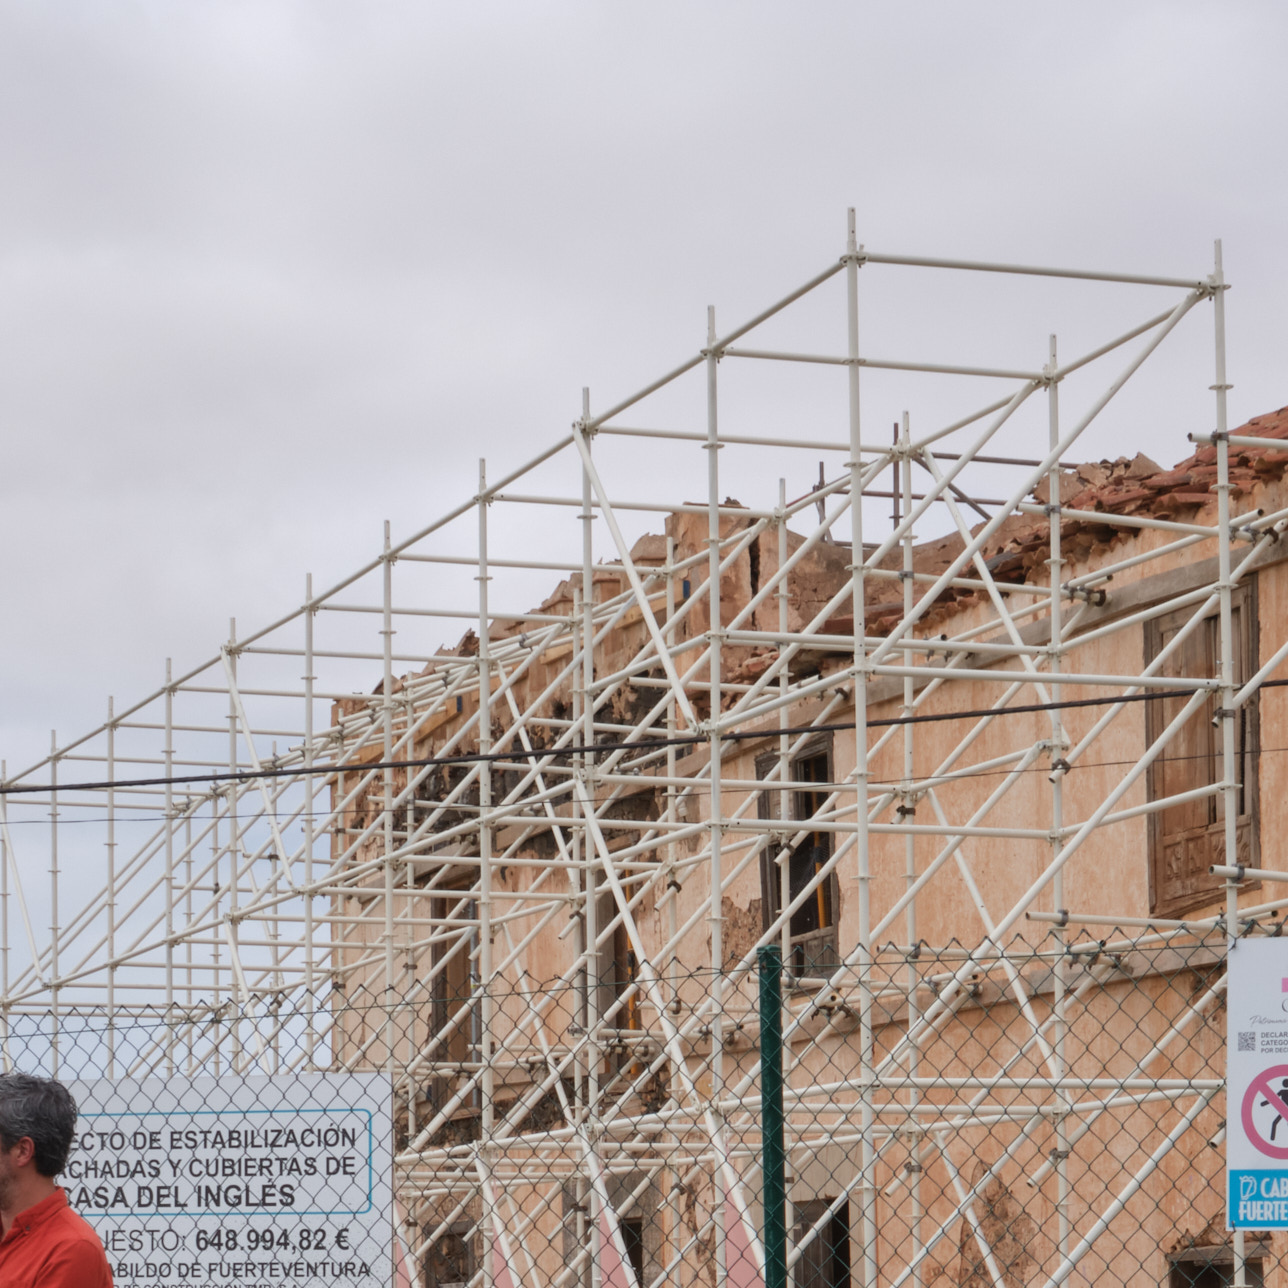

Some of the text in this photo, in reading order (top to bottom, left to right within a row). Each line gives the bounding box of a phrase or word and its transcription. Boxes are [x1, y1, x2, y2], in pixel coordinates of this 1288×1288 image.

[133, 1131, 162, 1150] DE
[170, 1123, 356, 1150] ESTABILIZACIÓN
[169, 1159, 182, 1178] Y
[189, 1157, 317, 1178] CUBIERTAS
[326, 1156, 356, 1176] DE
[137, 1185, 188, 1208] DEL
[197, 1178, 295, 1208] INGLÉS
[195, 1228, 327, 1255] 648.994,82
[335, 1228, 350, 1251] €
[178, 1262, 202, 1278] DE
[208, 1261, 371, 1278] FUERTEVENTURA
